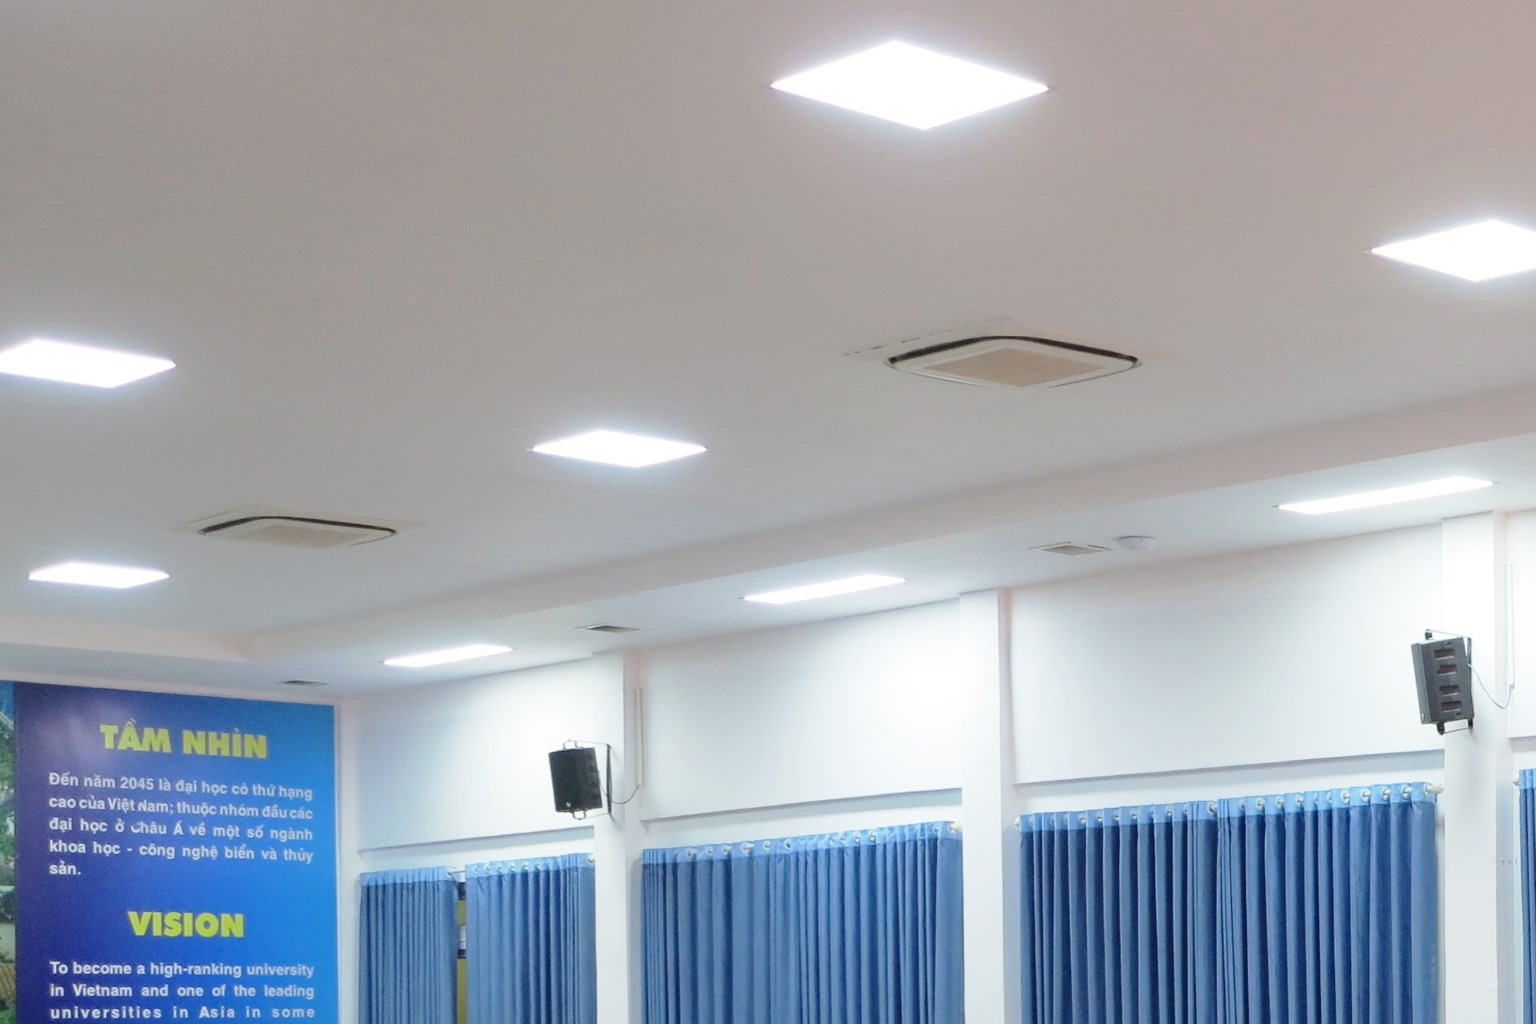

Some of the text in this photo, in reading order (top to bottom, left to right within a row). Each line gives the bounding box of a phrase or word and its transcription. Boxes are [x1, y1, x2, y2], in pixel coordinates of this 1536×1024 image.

[100, 718, 268, 759] TẦM NHÌN
[49, 771, 79, 786] Đến
[84, 774, 116, 788] năm
[120, 776, 154, 790] 2045
[158, 777, 171, 791] là
[175, 779, 197, 795] đại
[201, 781, 228, 796] học
[252, 784, 276, 796] thứ
[279, 785, 313, 801] hạng
[49, 794, 313, 819] cao của Việt Nam; thuộc nhóm đầu các
[49, 817, 72, 832] đại
[80, 818, 108, 834] học
[115, 818, 125, 832] ở
[173, 819, 184, 835] Á
[213, 825, 240, 839] một
[246, 824, 264, 838] số
[270, 827, 313, 842] ngành
[49, 839, 86, 853] khoa
[93, 841, 121, 857] học
[139, 843, 175, 859] công
[182, 845, 218, 860] nghệ
[224, 843, 255, 859] biển
[261, 847, 277, 860] và
[283, 847, 314, 864] thủy
[49, 860, 81, 875] sản.
[127, 911, 244, 938] VISION
[50, 961, 314, 979] To become a high-ranking university
[50, 983, 314, 1000] in Vietnam and one of the leading
[50, 1006, 315, 1019] universities in Asia in some
